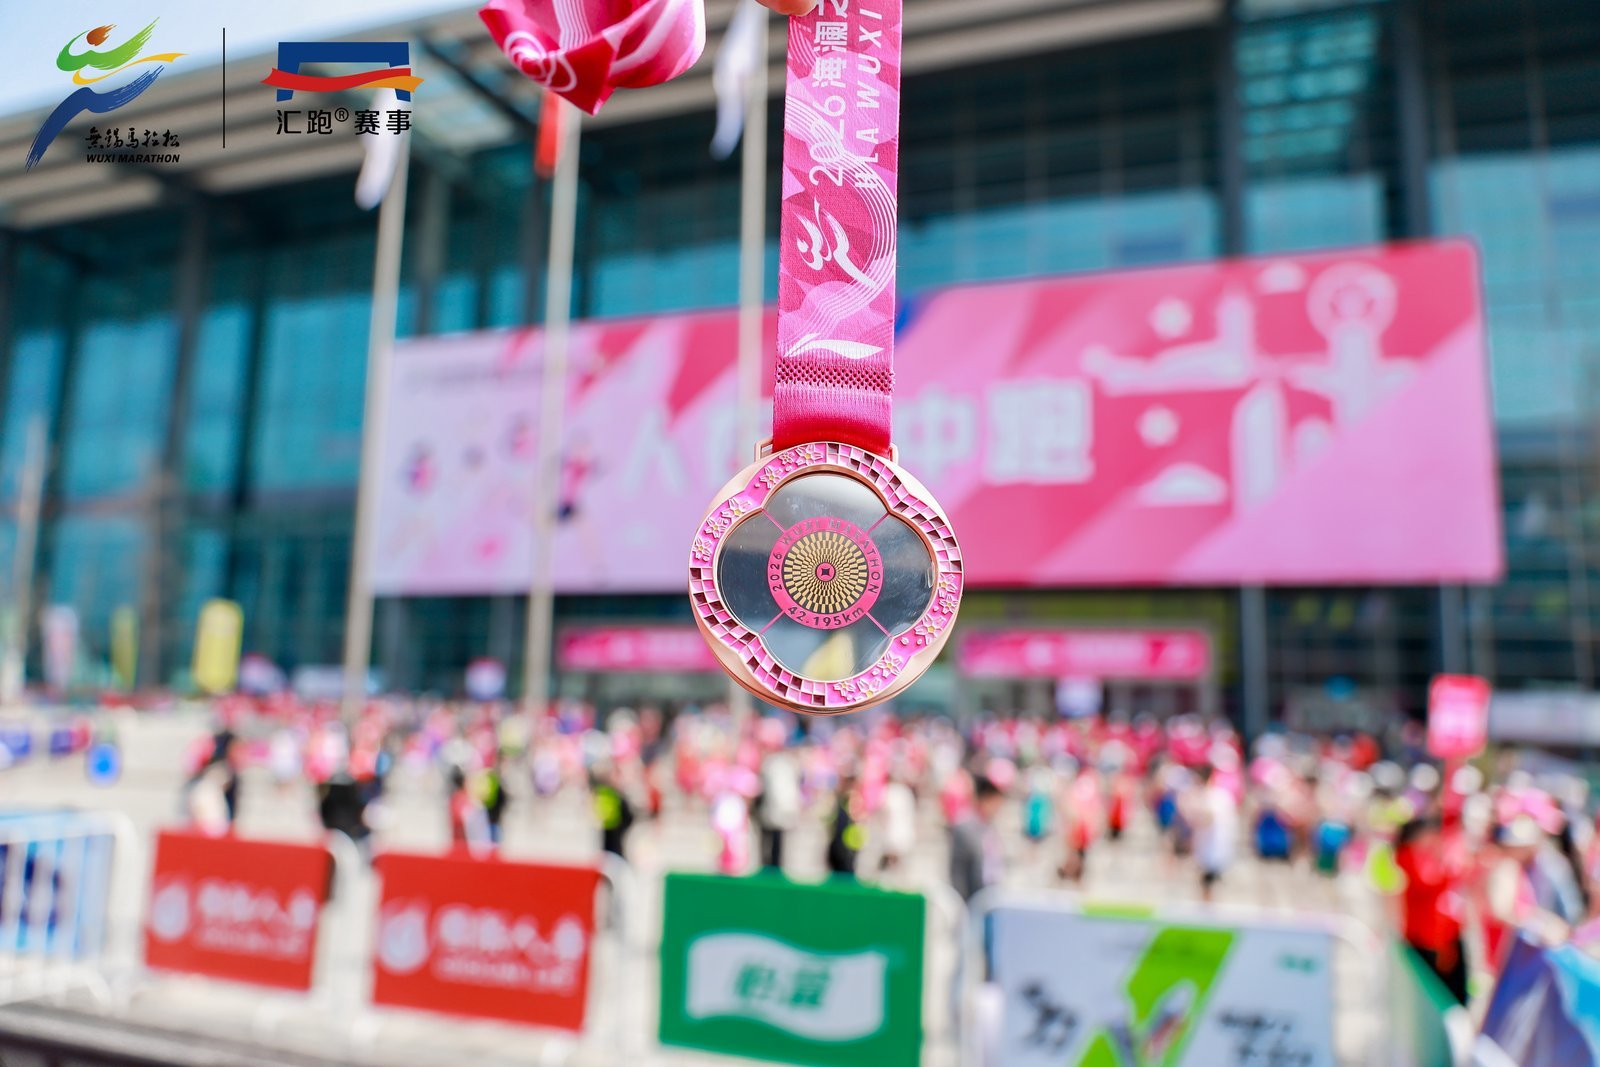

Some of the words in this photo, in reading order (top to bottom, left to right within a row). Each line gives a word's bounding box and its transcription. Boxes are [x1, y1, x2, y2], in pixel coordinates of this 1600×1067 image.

[857, 8, 883, 109] WUXI
[770, 552, 783, 592] 2026
[780, 520, 820, 546] WUXI
[829, 520, 881, 594] MARATHON
[788, 606, 864, 627] 42.195km
